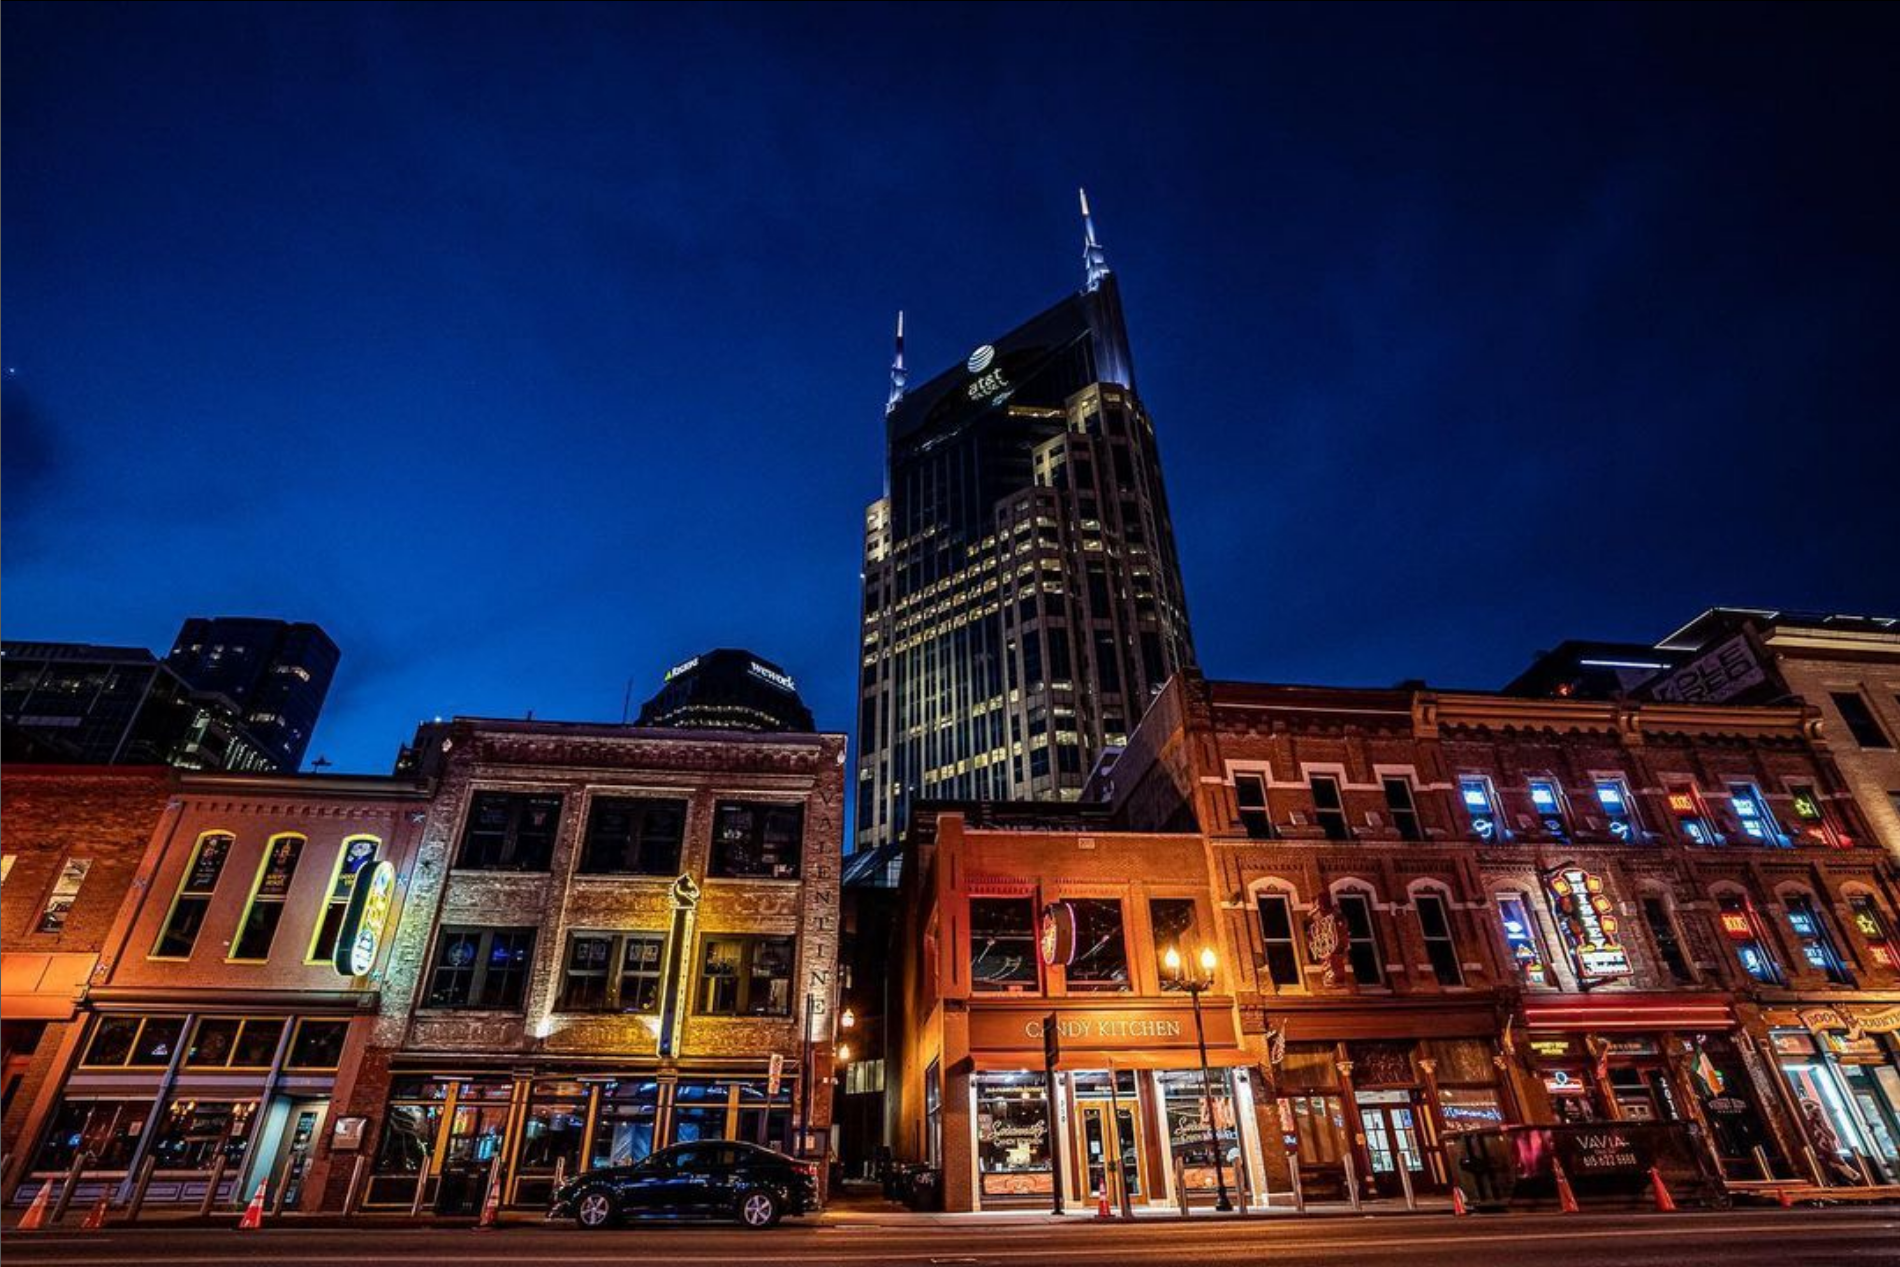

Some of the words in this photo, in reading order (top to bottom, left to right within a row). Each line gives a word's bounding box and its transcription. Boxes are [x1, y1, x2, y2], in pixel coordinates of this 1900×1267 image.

[1677, 643, 1743, 686] OLE
[810, 791, 834, 1014] VALENTINE
[1025, 1021, 1091, 1038] CNDY
[1099, 1020, 1180, 1036] KITCHEN
